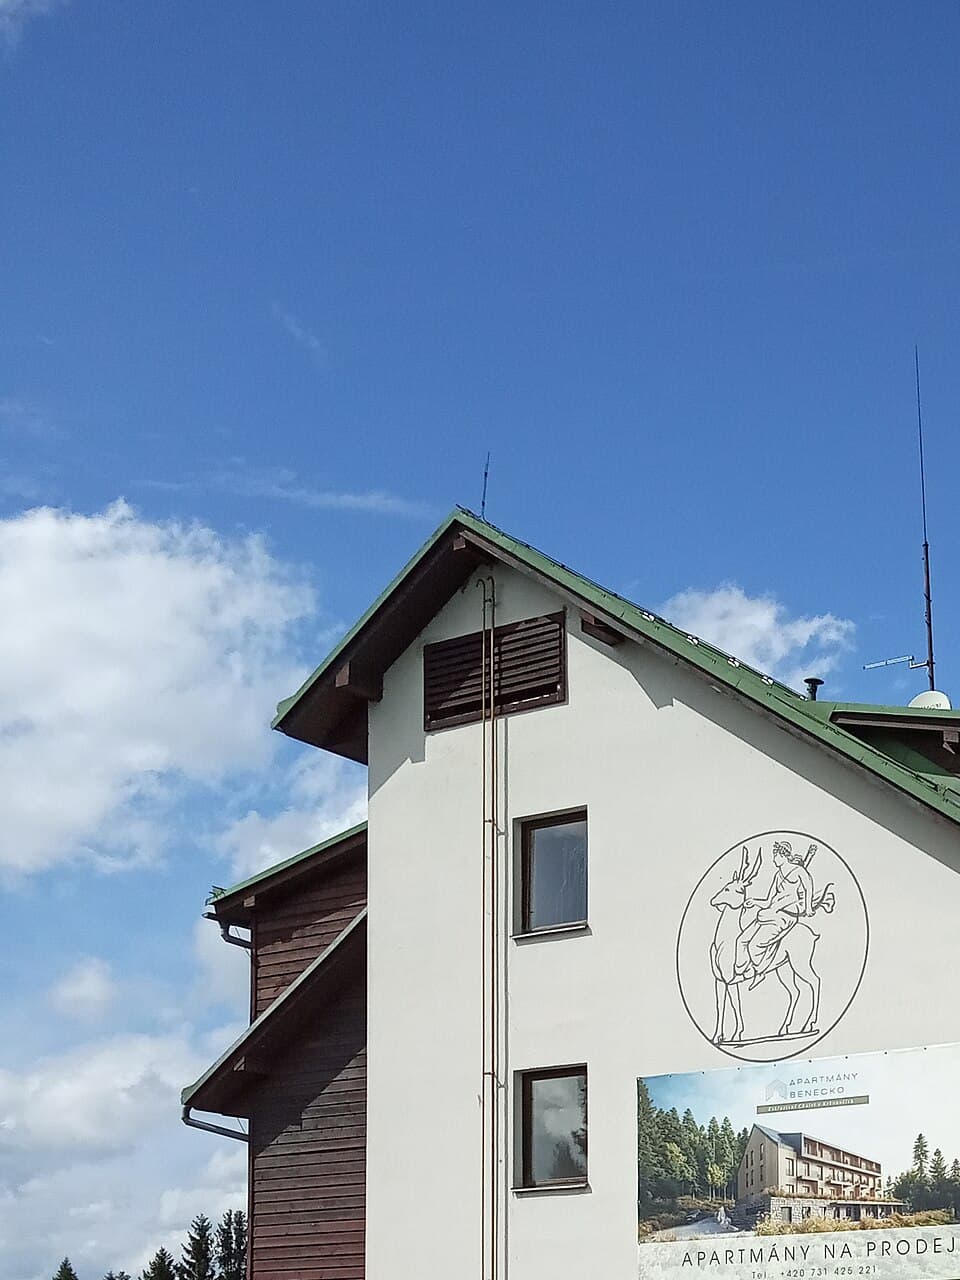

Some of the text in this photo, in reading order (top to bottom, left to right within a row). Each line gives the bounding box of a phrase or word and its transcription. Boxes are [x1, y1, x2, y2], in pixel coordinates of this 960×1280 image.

[789, 1086, 845, 1098] BENECKO
[681, 1236, 956, 1267] APARTMÁNY NA PRODEJ
[780, 1269, 805, 1278] +420
[810, 1267, 828, 1277] 731
[834, 1266, 853, 1275] 425
[858, 1264, 877, 1275] 221
